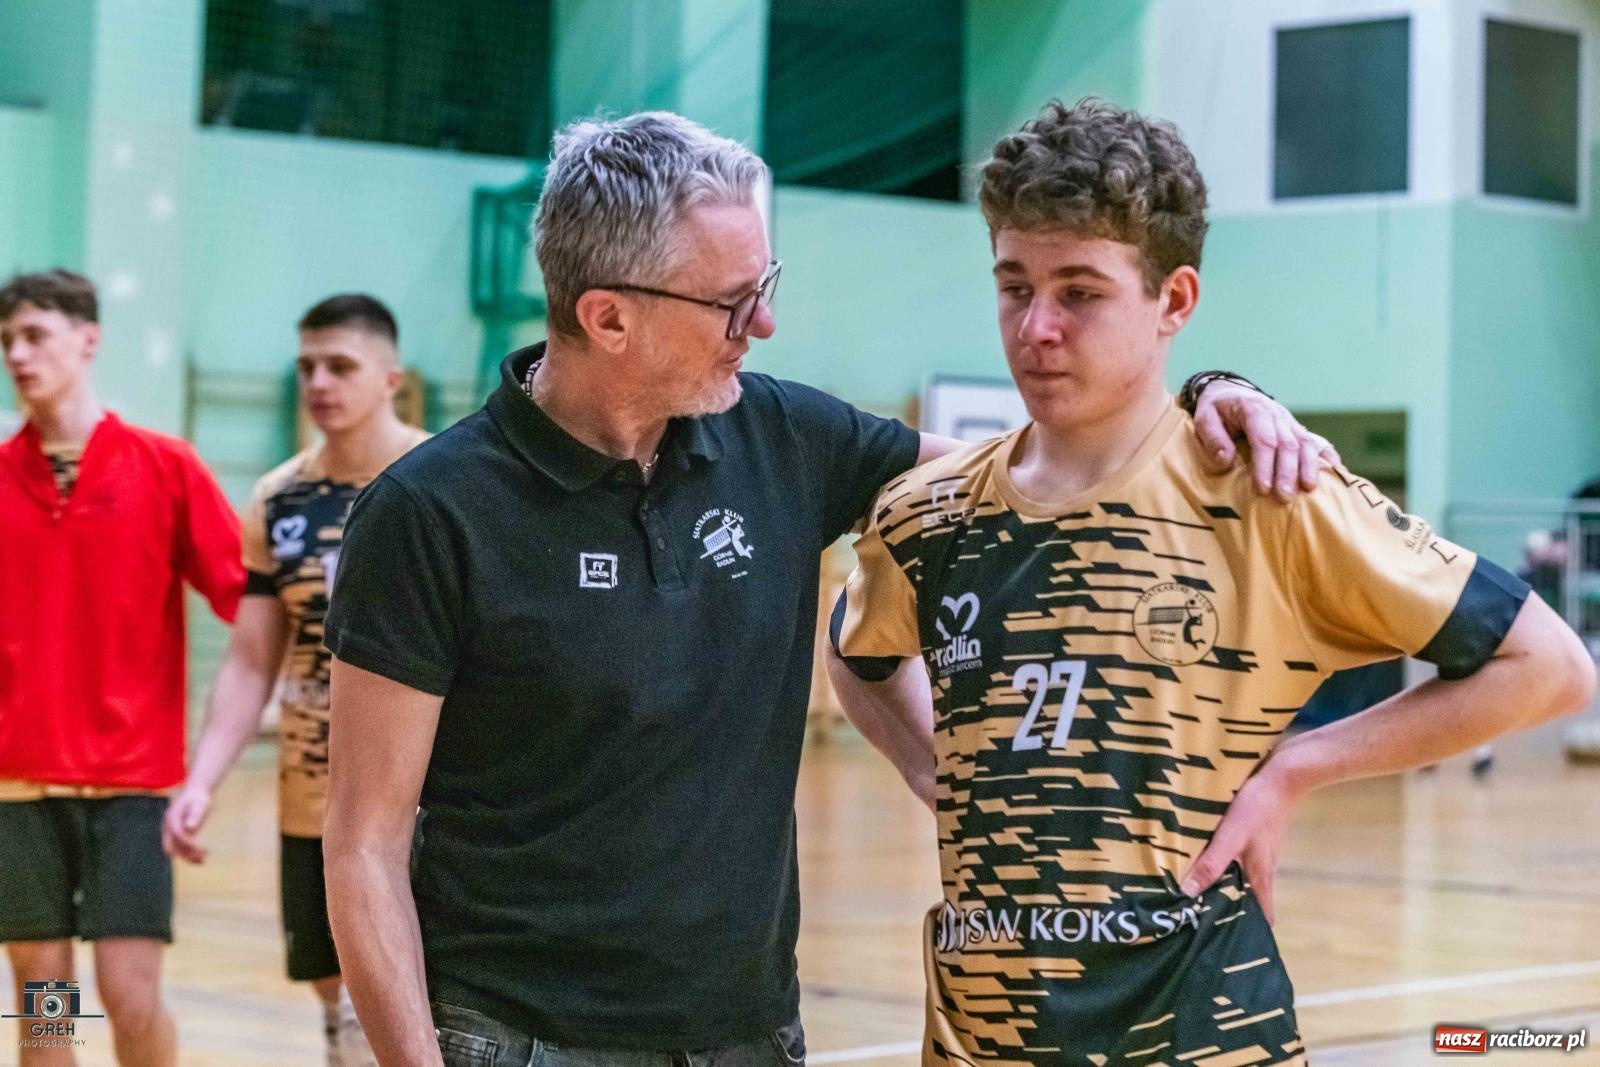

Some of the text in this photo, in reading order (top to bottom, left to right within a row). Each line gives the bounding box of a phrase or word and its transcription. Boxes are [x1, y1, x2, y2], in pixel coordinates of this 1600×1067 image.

[1012, 660, 1087, 751] 27
[1030, 907, 1140, 944] KOKS
[1151, 906, 1200, 939] SA
